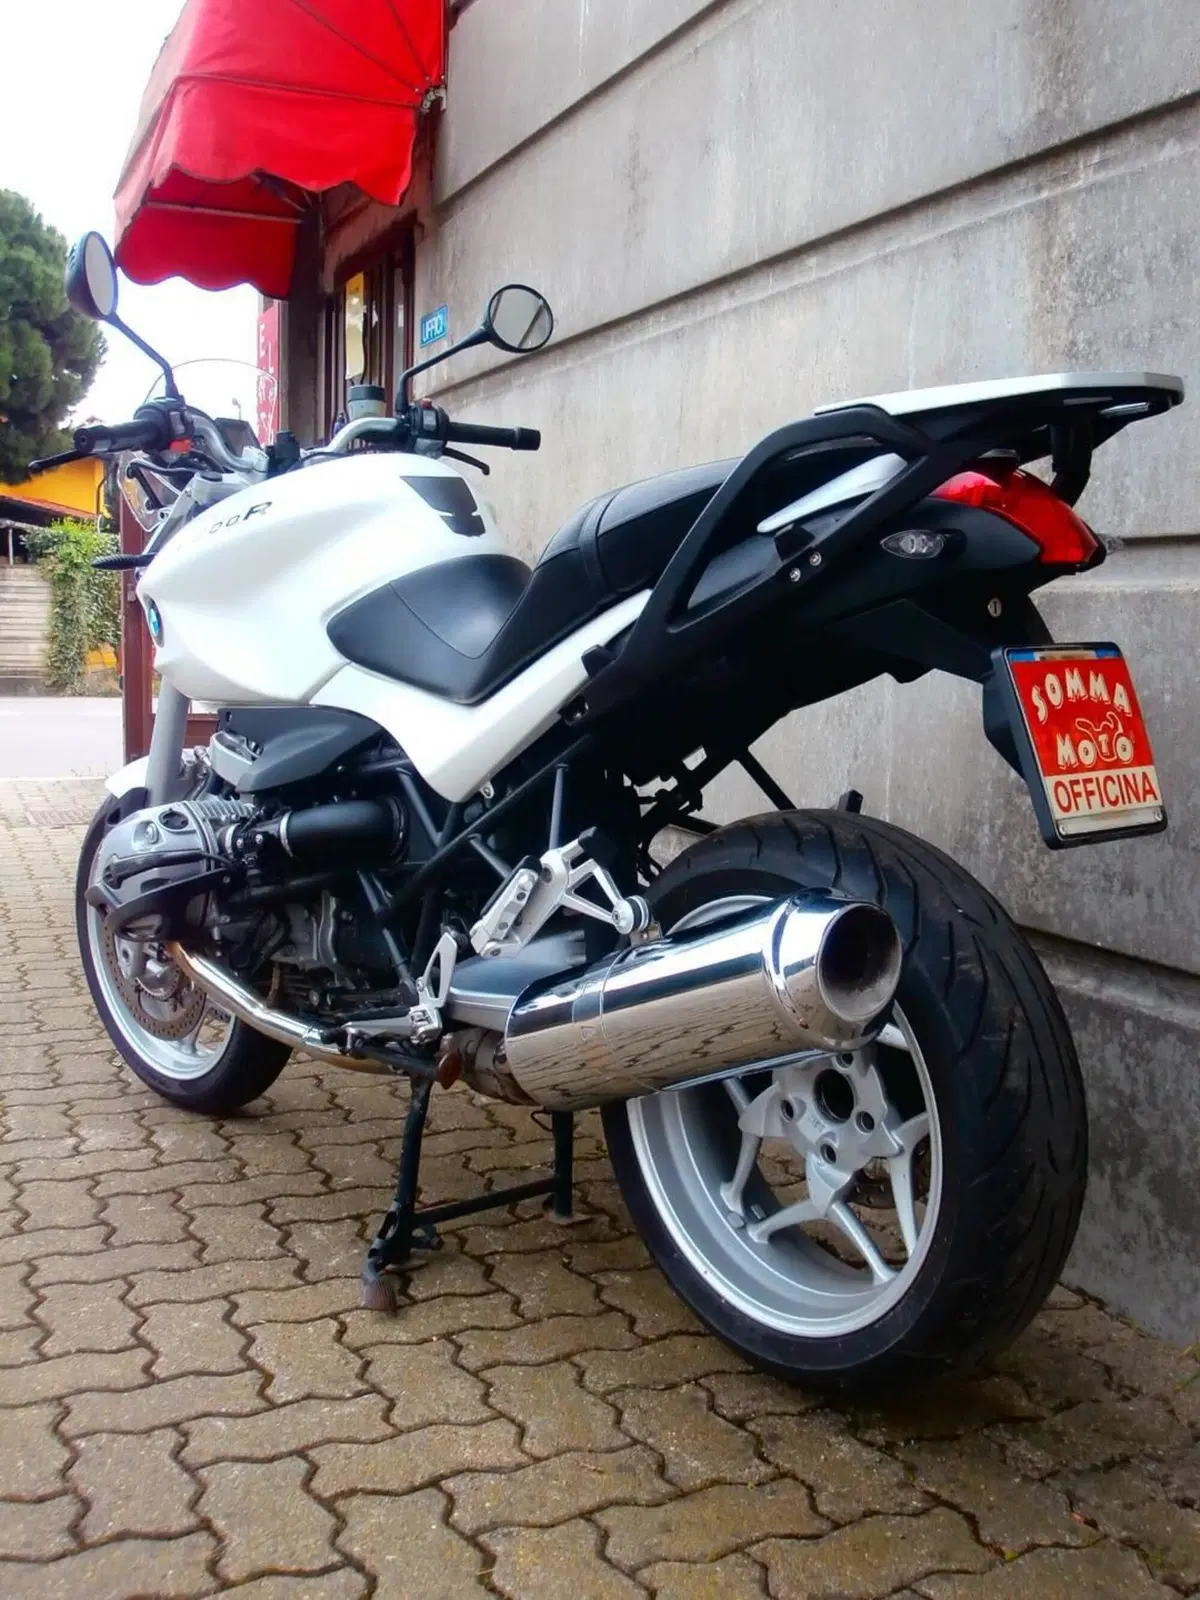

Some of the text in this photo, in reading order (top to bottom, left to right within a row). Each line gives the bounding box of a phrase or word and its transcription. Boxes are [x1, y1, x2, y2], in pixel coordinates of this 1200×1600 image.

[1031, 667, 1133, 725] SOMMA
[1056, 732, 1134, 770] MOTO
[1053, 771, 1159, 814] OFFICINA
